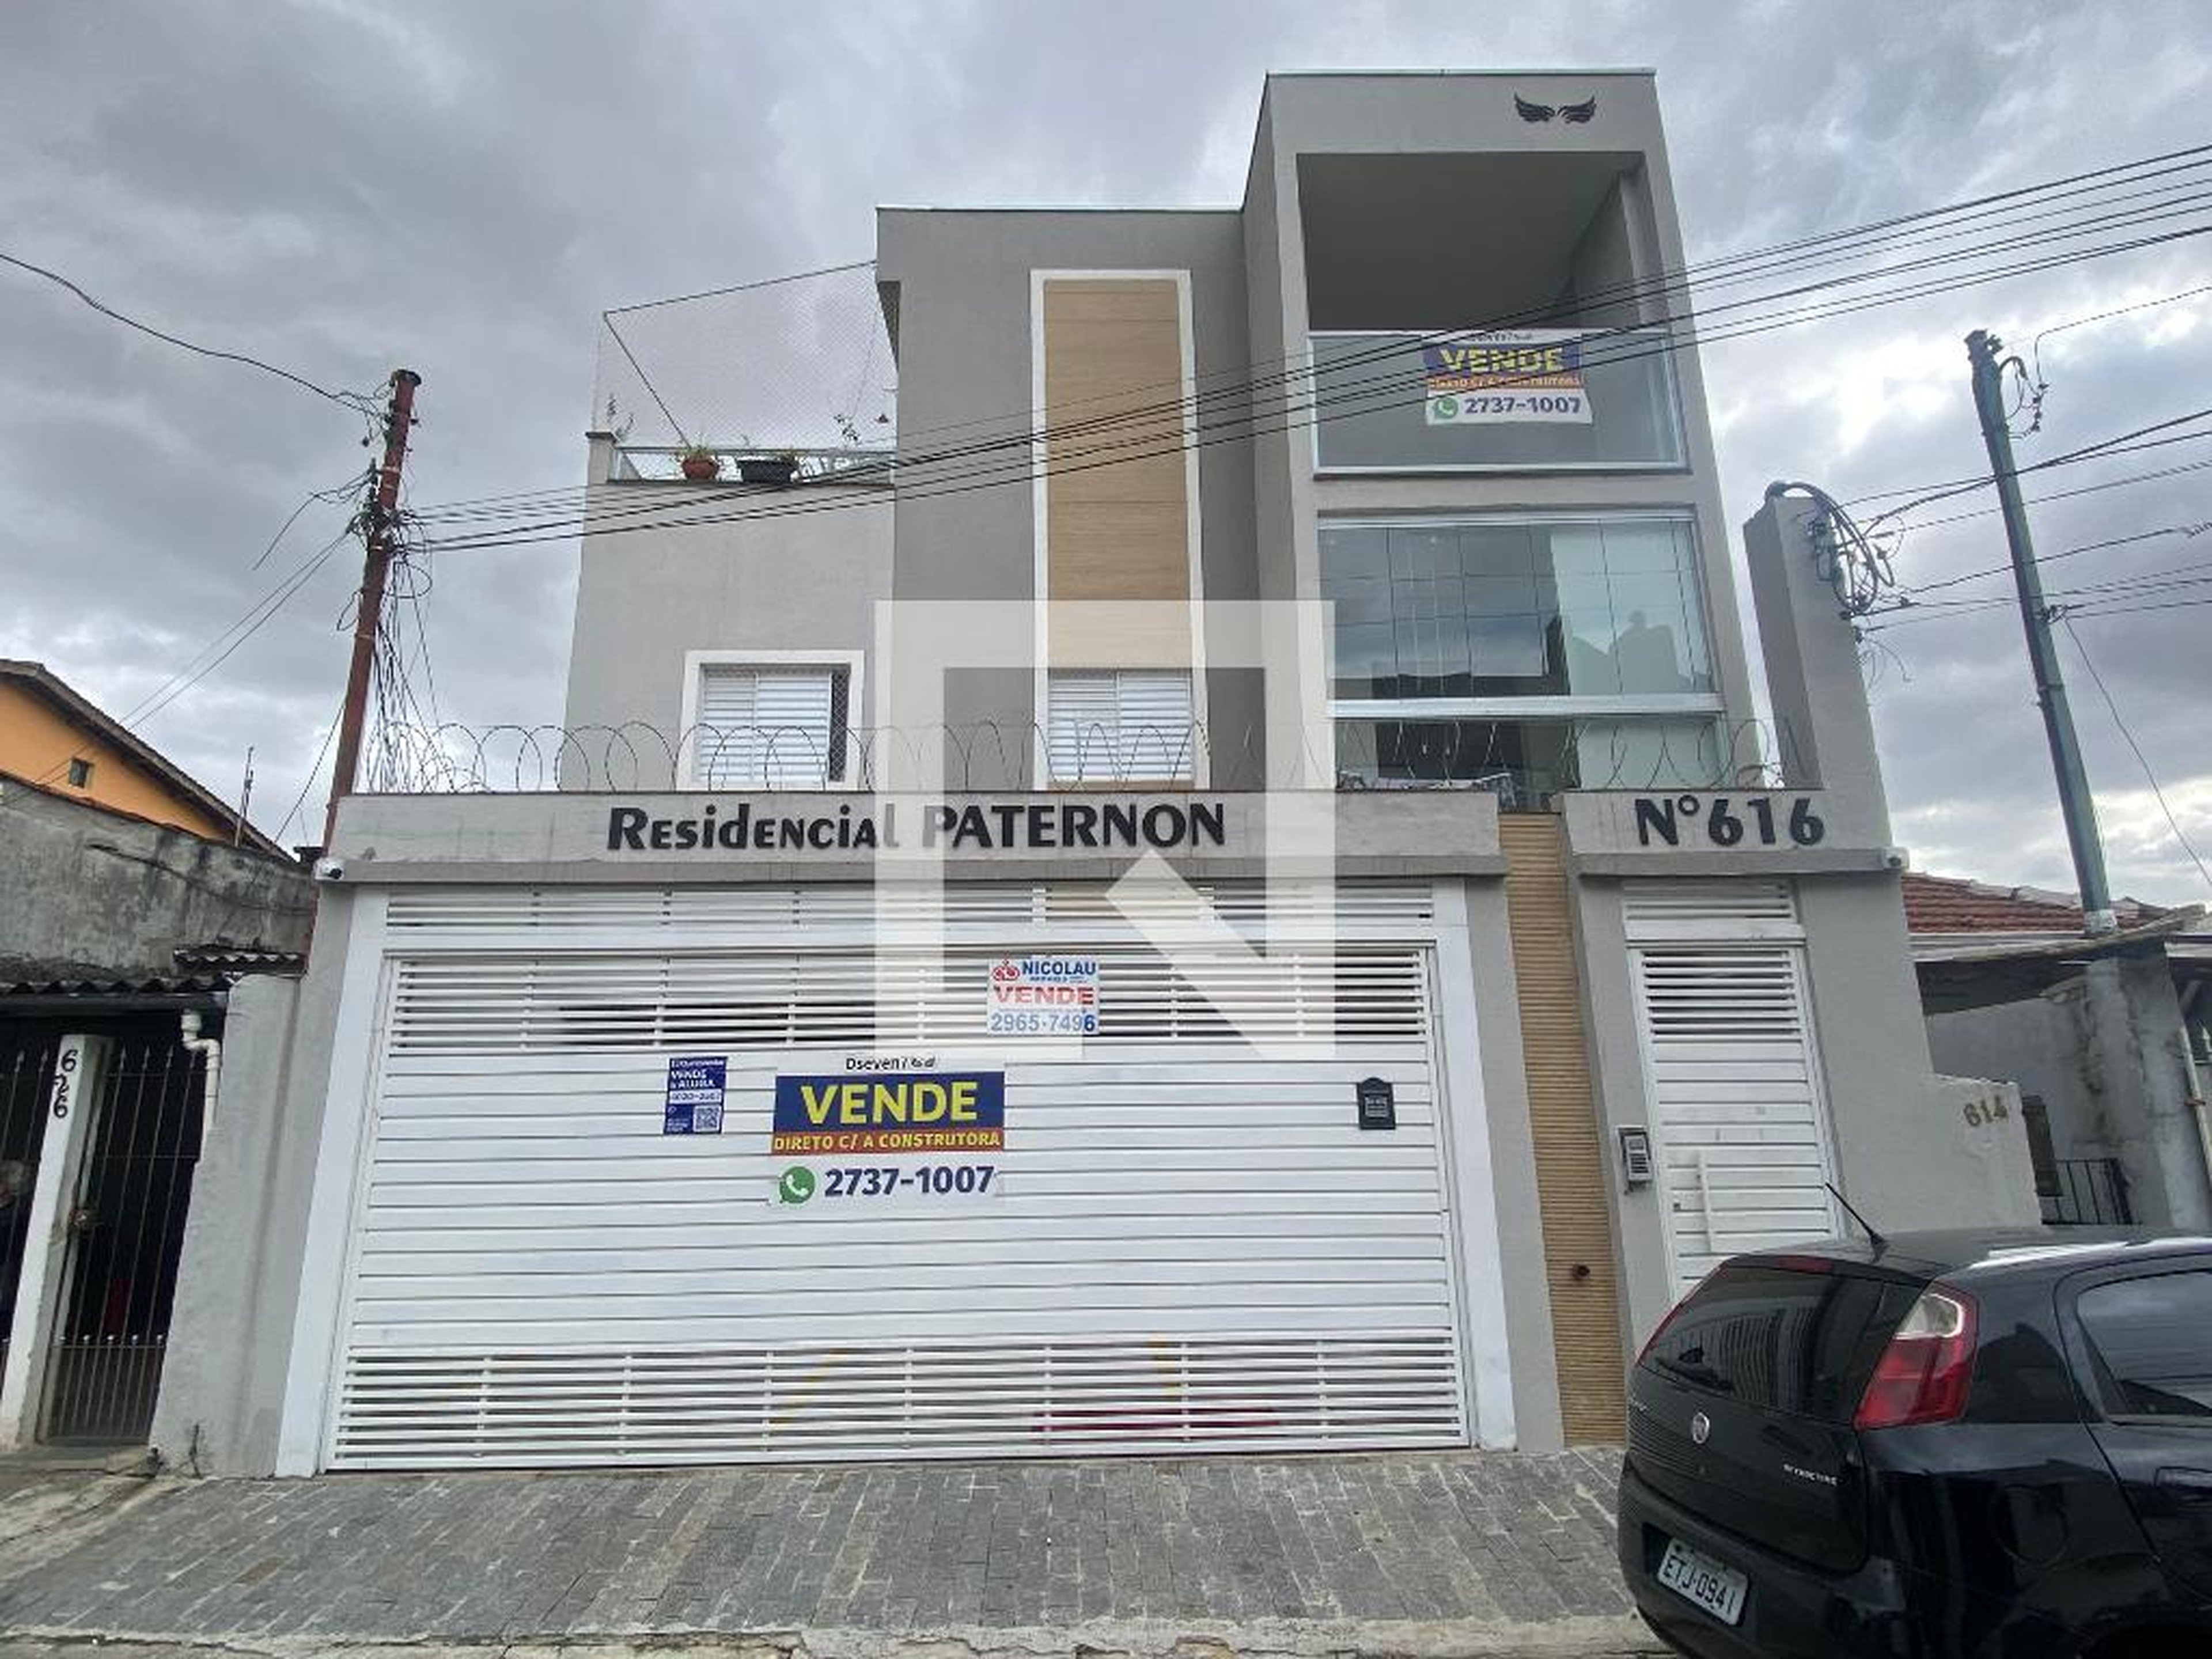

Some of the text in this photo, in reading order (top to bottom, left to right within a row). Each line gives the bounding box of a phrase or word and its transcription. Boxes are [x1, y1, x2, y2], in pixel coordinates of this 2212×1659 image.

[1441, 349, 1563, 372] VENDE
[1464, 397, 1581, 414] 2737-1007
[922, 802, 1225, 848] PATERNON
[1022, 961, 1096, 975] NICOLAU
[993, 986, 1094, 1005] VENDE
[800, 1081, 978, 1124] VENDE
[775, 1132, 1001, 1150] DIRETO C/ A CONSTRUTORA
[824, 1165, 995, 1198] 2737-1007
